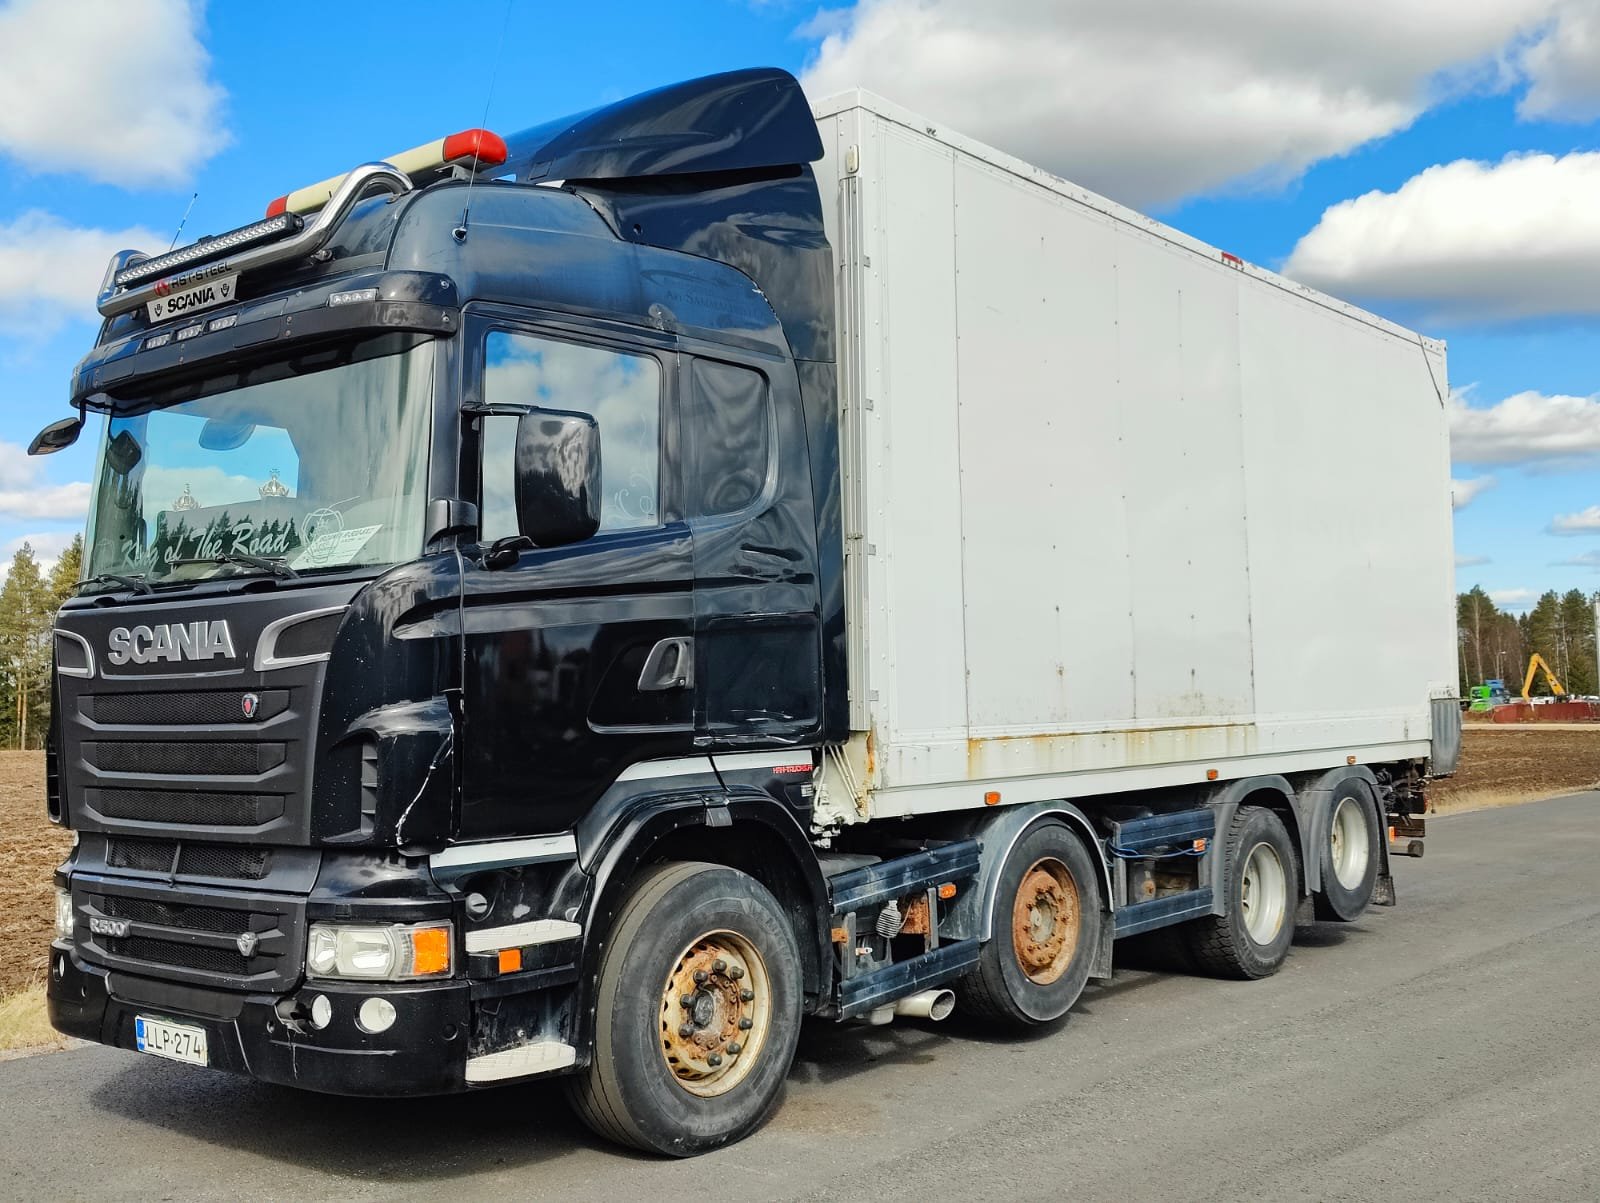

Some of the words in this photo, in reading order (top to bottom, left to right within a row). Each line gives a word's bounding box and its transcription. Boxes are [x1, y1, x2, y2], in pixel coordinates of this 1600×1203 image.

[167, 287, 215, 313] SCANIA
[189, 528, 222, 560] The
[230, 523, 290, 555] Road
[107, 620, 236, 666] SCANIA
[90, 917, 125, 937] R500
[146, 1025, 201, 1058] LLP-274
